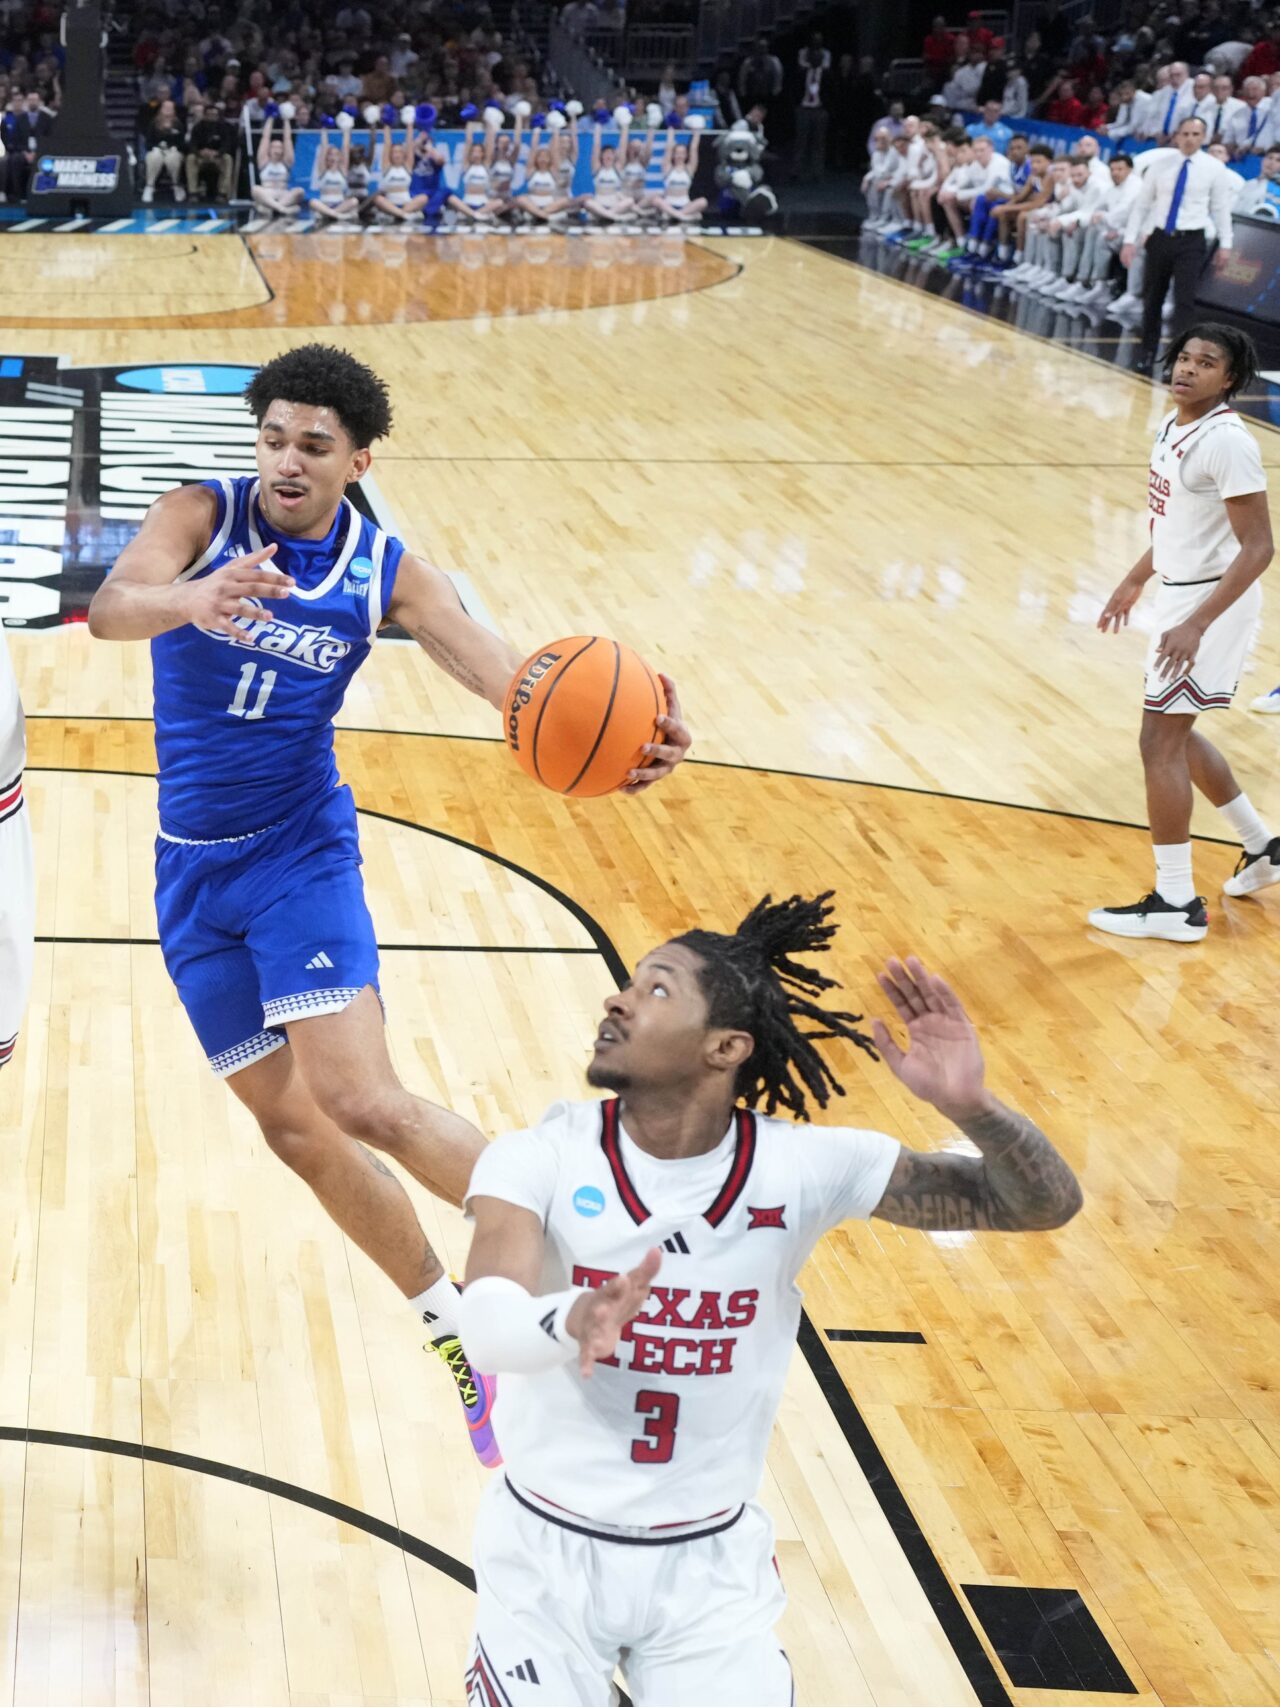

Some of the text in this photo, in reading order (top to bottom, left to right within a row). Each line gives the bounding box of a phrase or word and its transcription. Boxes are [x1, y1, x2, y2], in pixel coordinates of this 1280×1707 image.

[226, 661, 277, 720] 11
[509, 652, 563, 751] Wilson
[631, 1390, 680, 1463] 3
